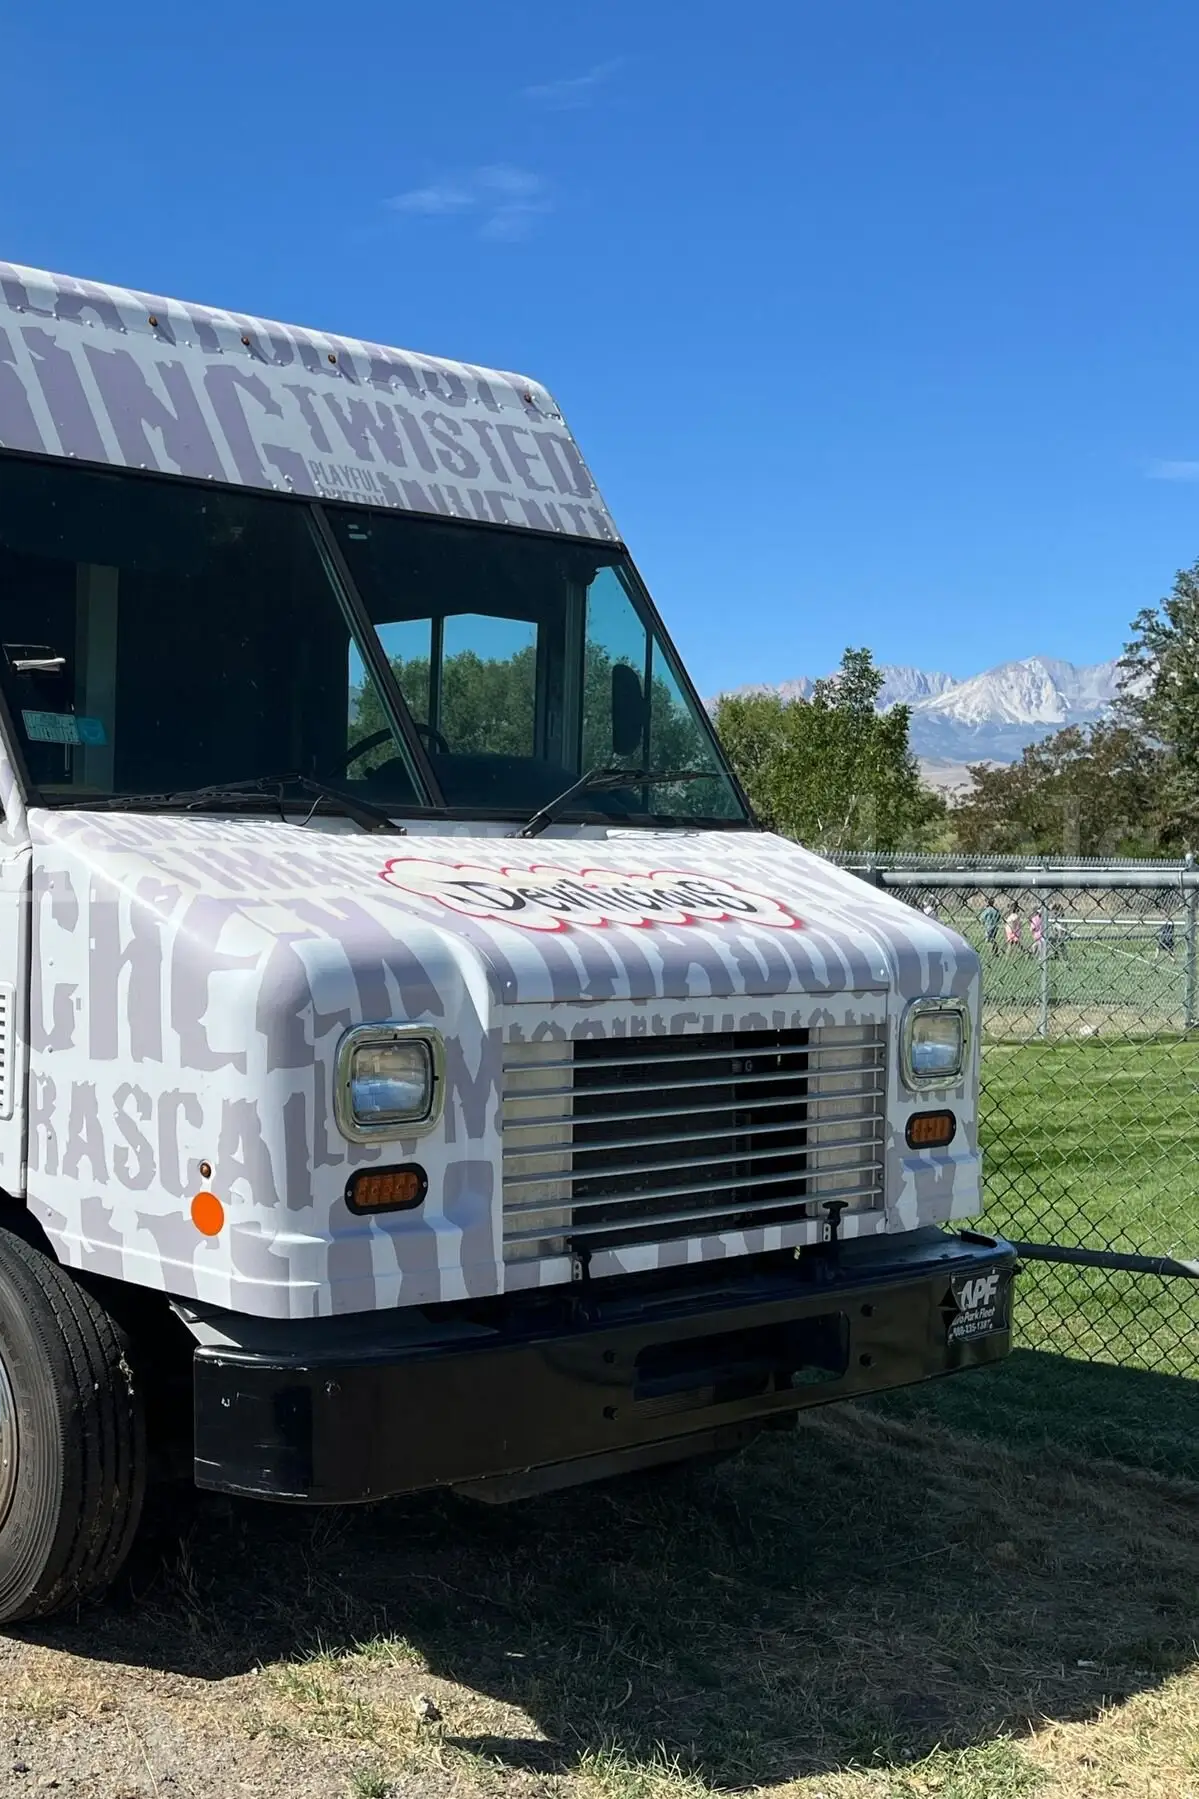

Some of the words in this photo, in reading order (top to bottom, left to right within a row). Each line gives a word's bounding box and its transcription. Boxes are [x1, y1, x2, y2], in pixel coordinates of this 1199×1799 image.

[282, 384, 594, 499] TWISTED
[309, 459, 383, 493] PLAYFUL
[957, 1274, 1000, 1312] APF
